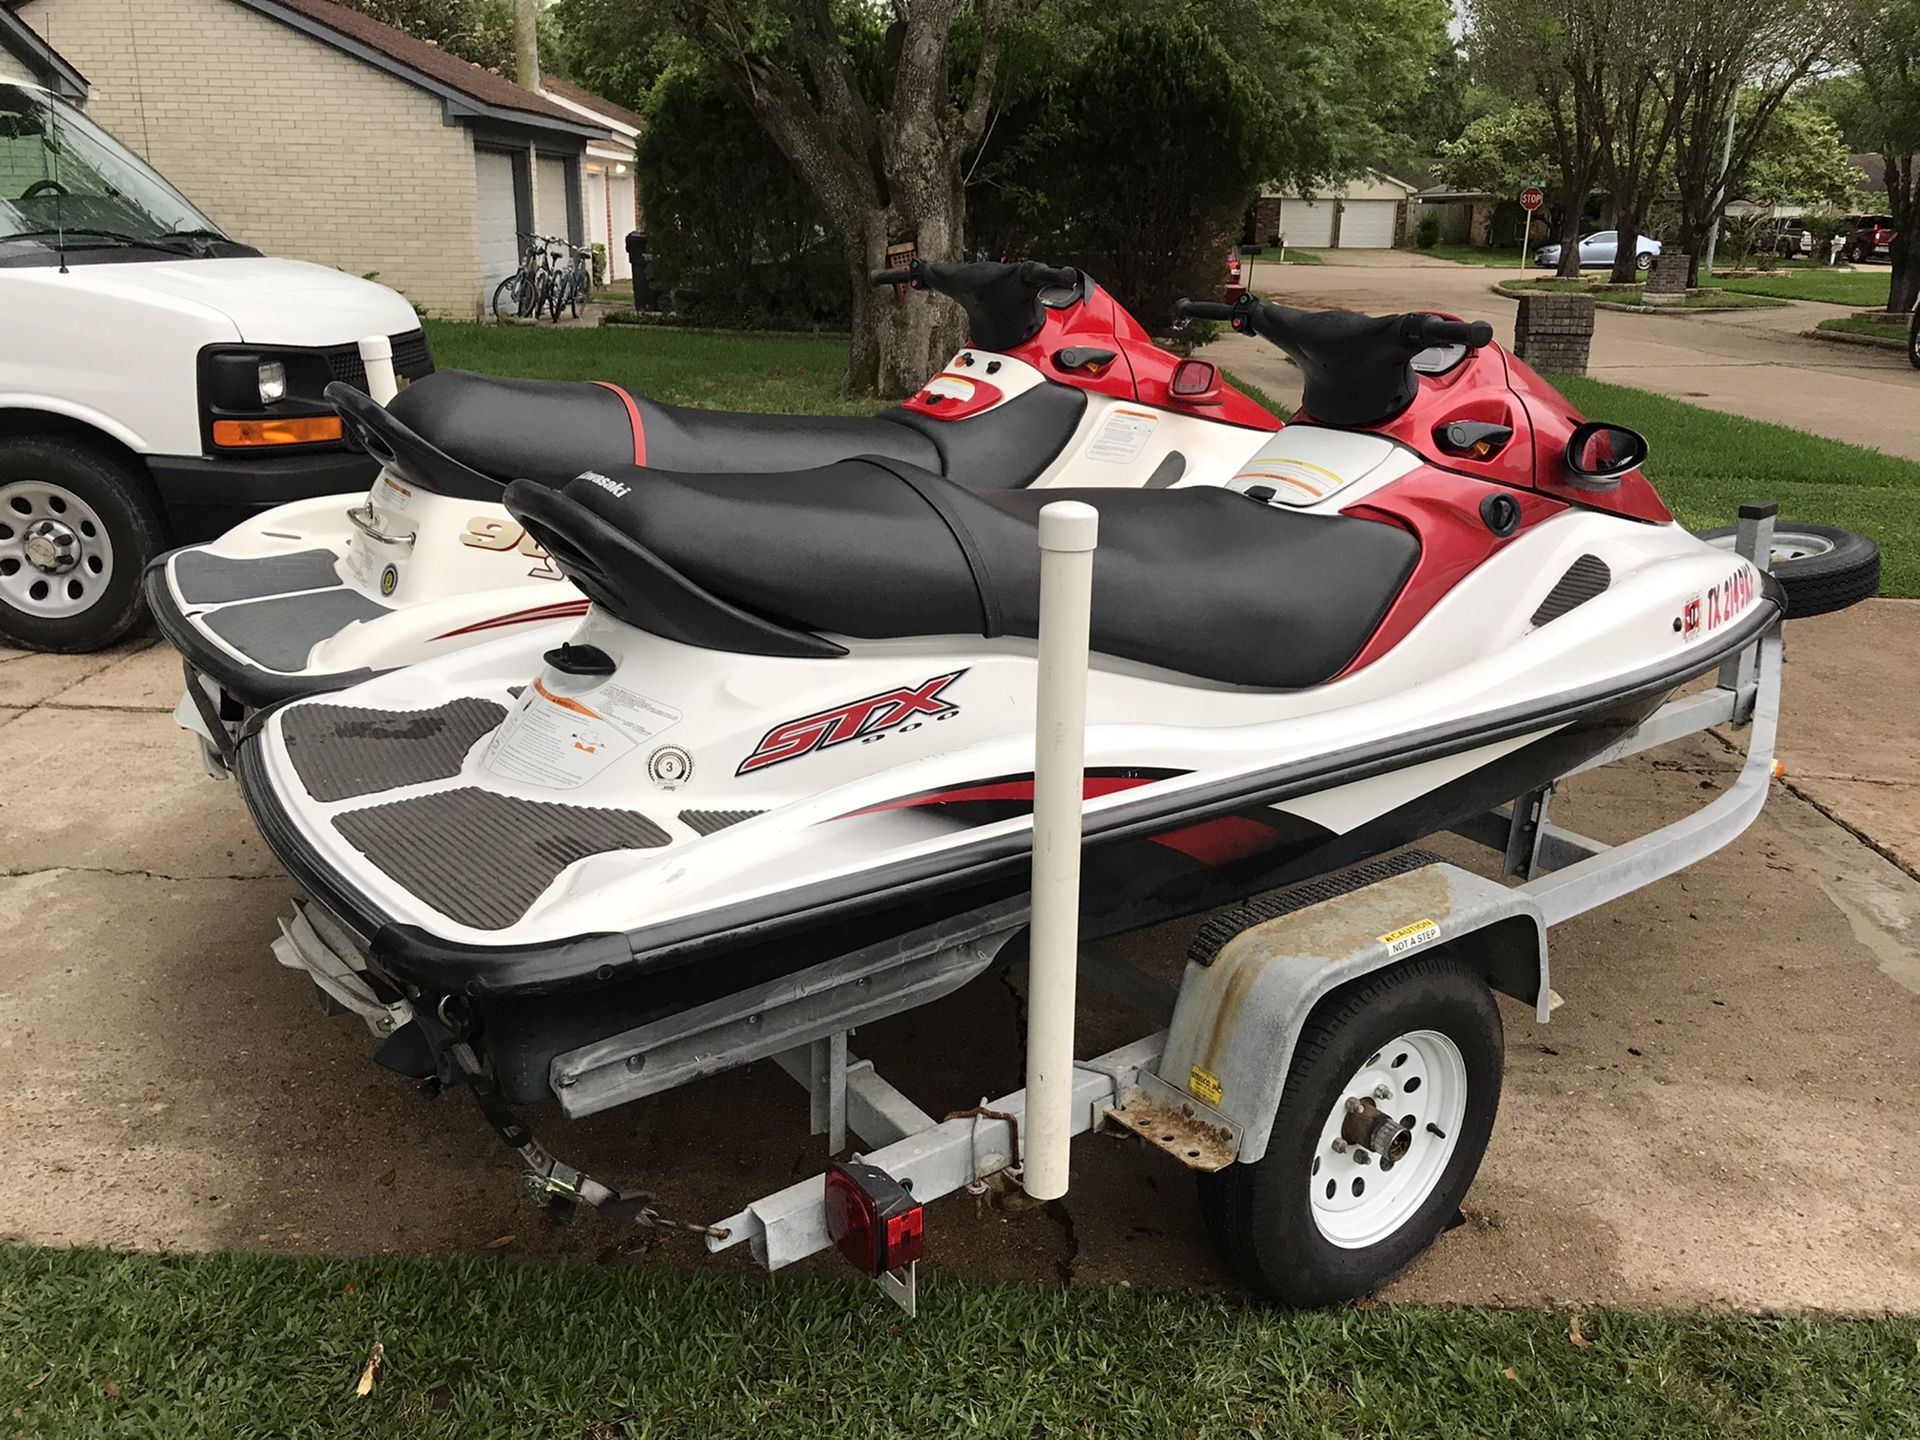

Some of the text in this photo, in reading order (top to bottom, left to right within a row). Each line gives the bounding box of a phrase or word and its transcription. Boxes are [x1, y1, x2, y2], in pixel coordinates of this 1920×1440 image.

[1522, 193, 1541, 203] STOP
[1707, 583, 1721, 631] TX
[735, 667, 971, 777] STX
[861, 710, 960, 745] 900
[666, 761, 673, 772] 3
[1391, 921, 1432, 939] CAUTION
[1392, 929, 1436, 953] NOT A STEP
